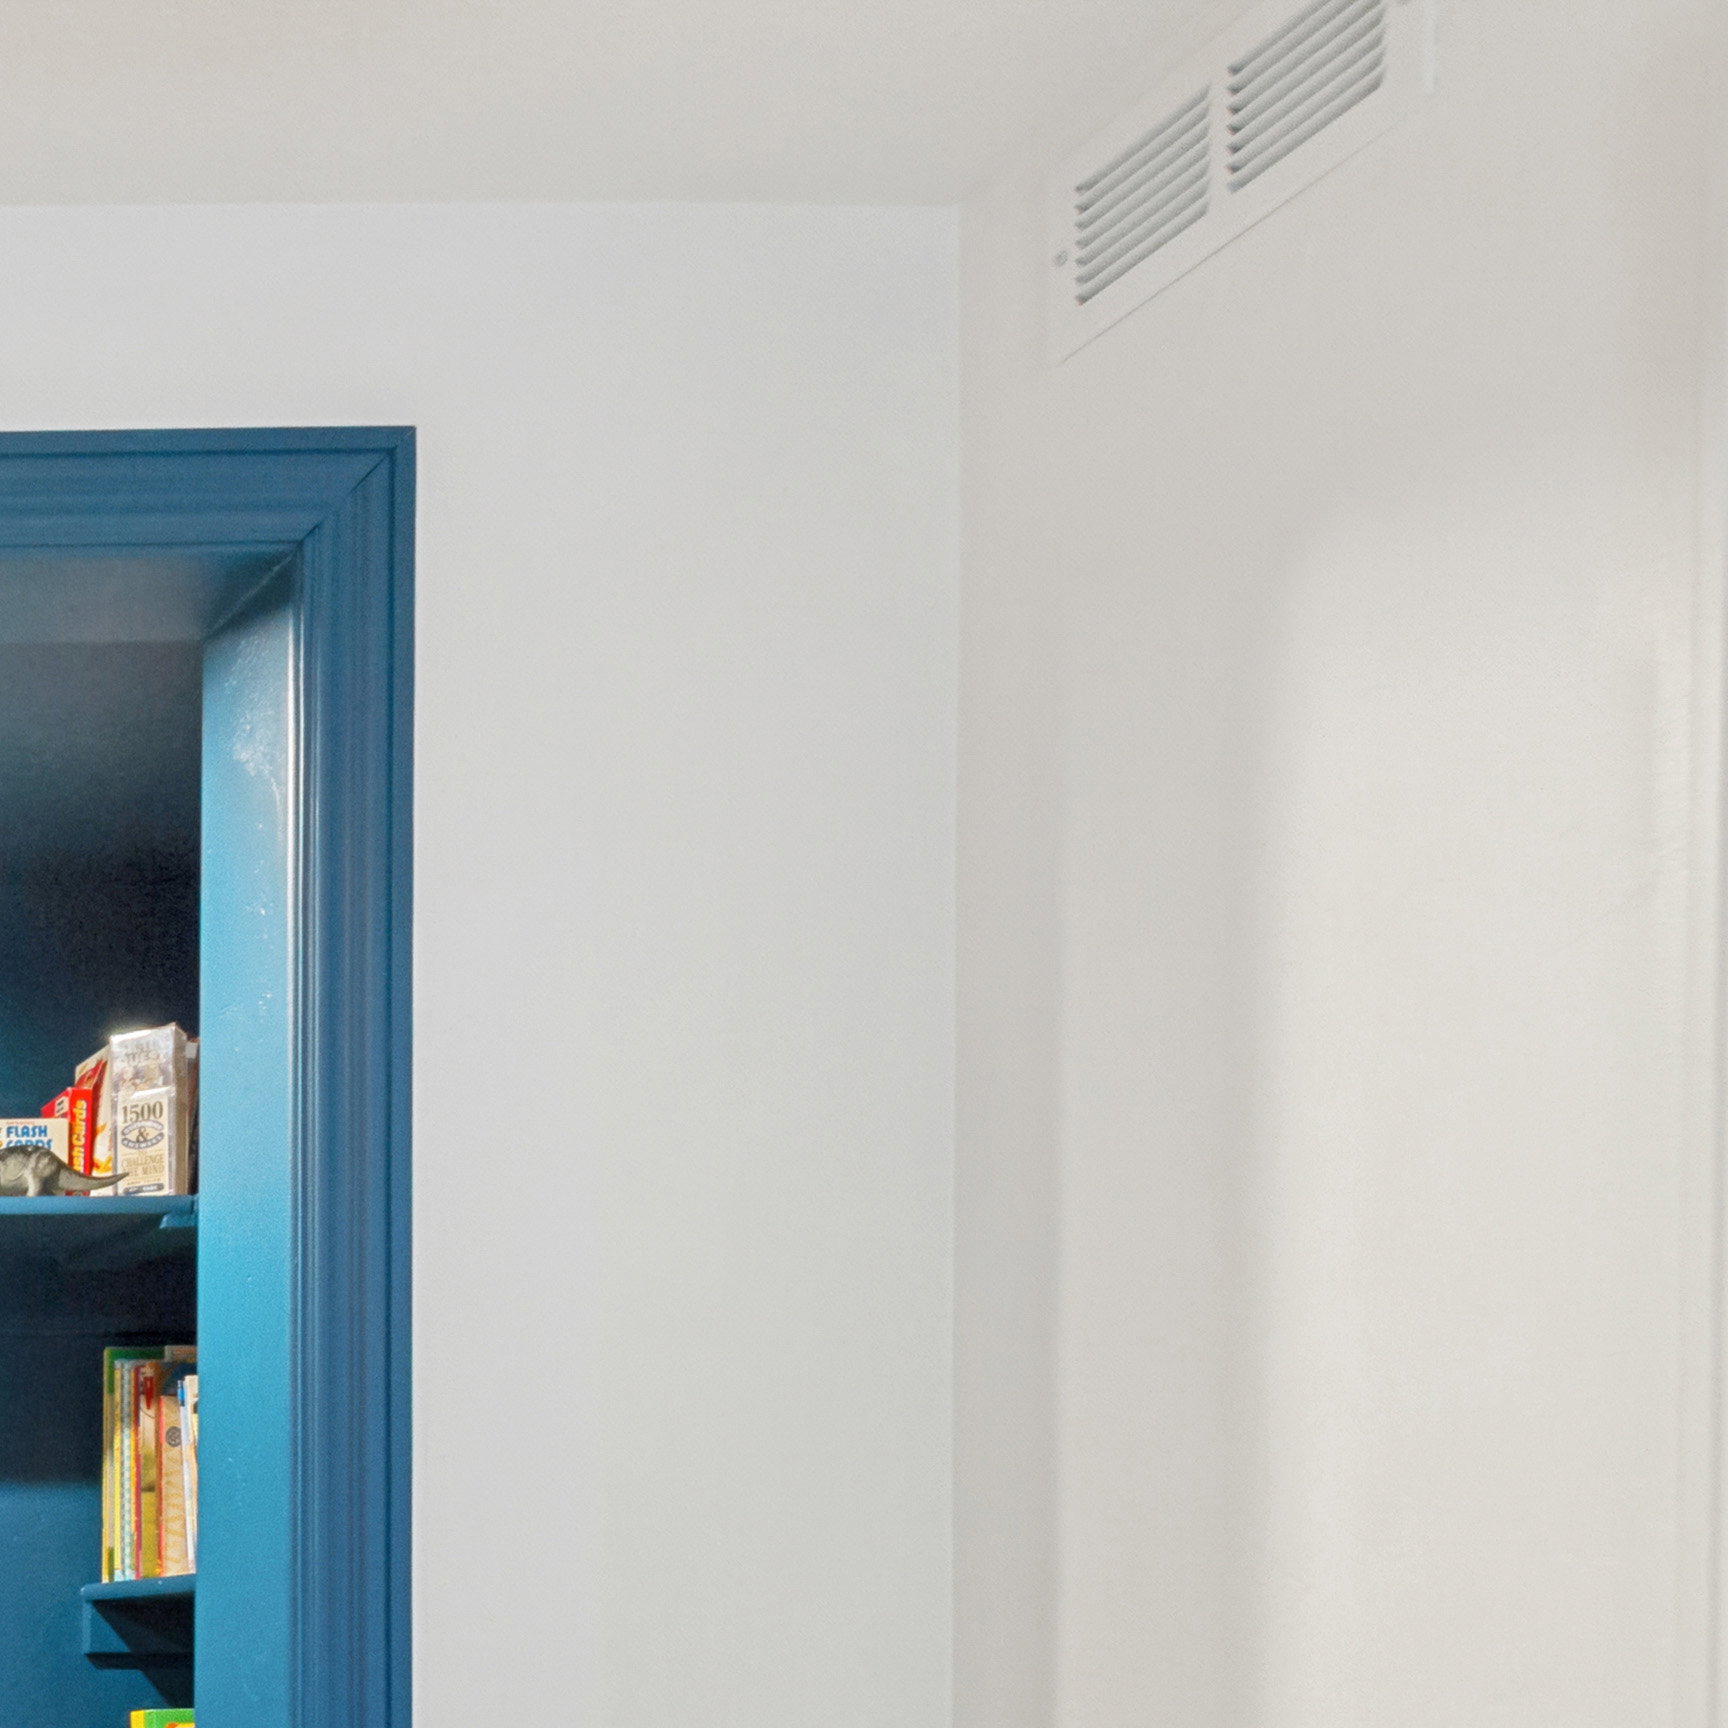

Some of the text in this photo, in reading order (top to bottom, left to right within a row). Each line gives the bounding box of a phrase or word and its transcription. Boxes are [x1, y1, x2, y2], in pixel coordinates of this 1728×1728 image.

[73, 1100, 87, 1147] Cards
[122, 1101, 164, 1124] 1500
[6, 1125, 47, 1138] FLASH
